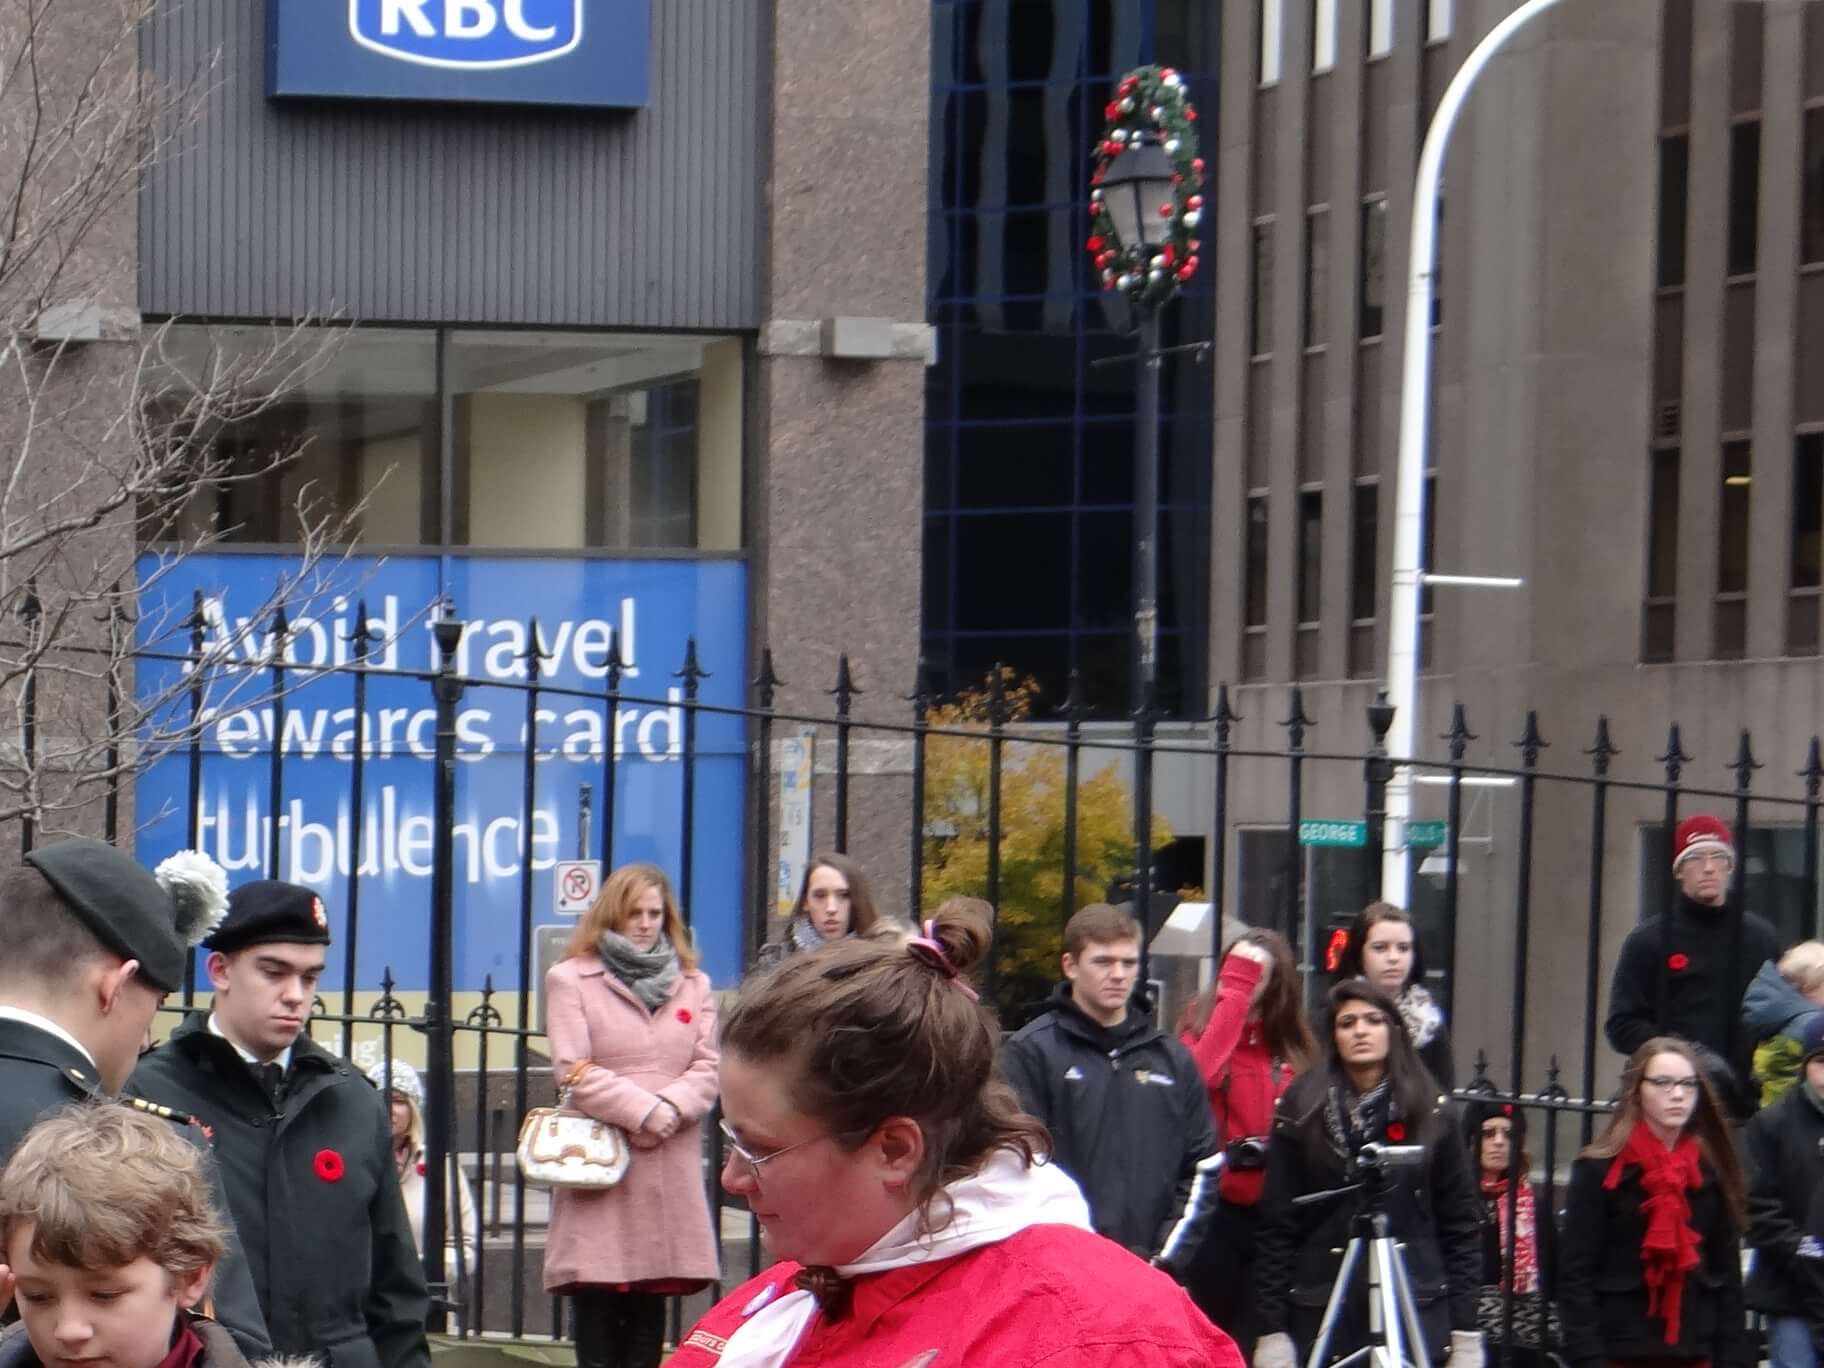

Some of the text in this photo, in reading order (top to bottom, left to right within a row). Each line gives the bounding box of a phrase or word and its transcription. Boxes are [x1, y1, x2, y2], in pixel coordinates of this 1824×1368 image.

[380, 0, 557, 41] RBC
[182, 594, 640, 678] Avoid travel
[520, 687, 681, 763] card
[198, 785, 560, 884] turbulence
[1299, 823, 1358, 842] GEORGE
